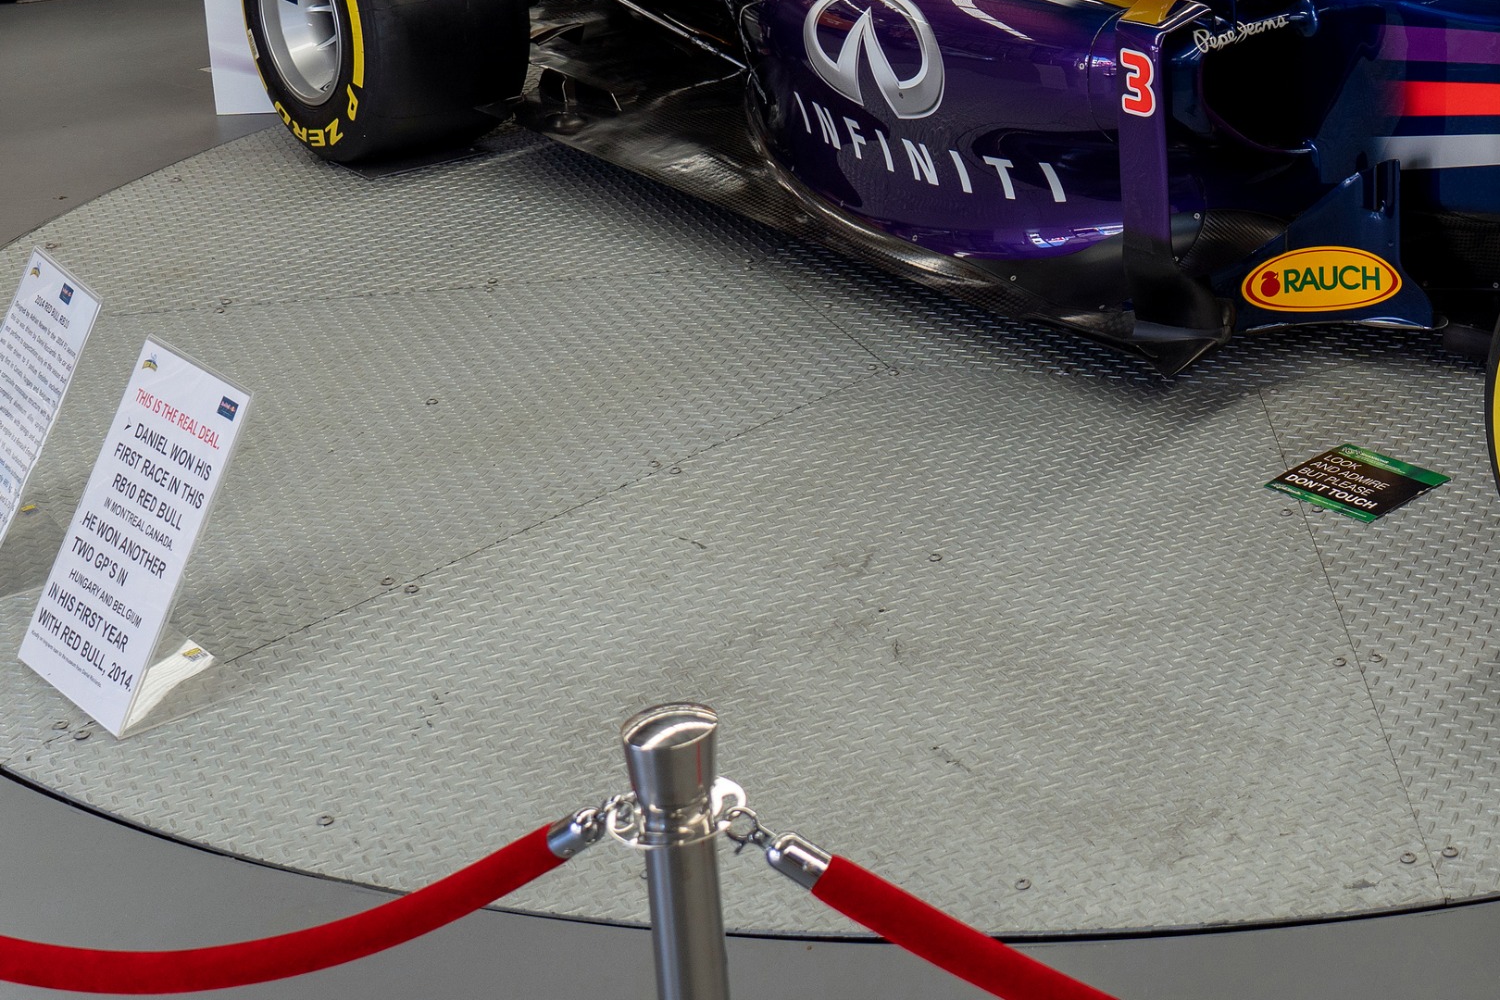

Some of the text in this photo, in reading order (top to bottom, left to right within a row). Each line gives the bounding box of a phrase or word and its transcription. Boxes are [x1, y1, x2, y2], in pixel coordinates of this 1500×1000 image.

[1193, 28, 1238, 54] Pepe
[1120, 48, 1156, 117] 3
[274, 83, 360, 147] P ZERO
[793, 89, 1068, 204] INFINITI
[1282, 263, 1382, 295] RAUCH
[42, 300, 61, 322] RED BULL
[133, 387, 224, 451] THIS IS THE REAL DEAL.
[112, 441, 205, 511] FIRST RACE IN THIS
[132, 422, 213, 482] DANIEL WON HIS
[1295, 466, 1376, 496] BUT PLEASE
[1308, 459, 1343, 473] AND
[1336, 469, 1391, 491] ADMIRE
[1321, 453, 1363, 470] LOOK
[110, 471, 186, 532] RB10 RED BULL
[1282, 473, 1331, 492] DON'T
[1323, 487, 1380, 509] TOUCH
[94, 519, 167, 581] WON ANOTHER
[102, 495, 176, 553] IN MONTREAL CANADA.
[69, 534, 129, 588] TWO GP'S IN
[46, 579, 130, 654] IN HIS FIRST YEAR
[67, 566, 143, 630] HUNGARY AND BELGIUM
[35, 605, 63, 638] WITH
[58, 623, 83, 653] RED
[77, 638, 110, 677] BULL,
[106, 659, 136, 695] 2014.
